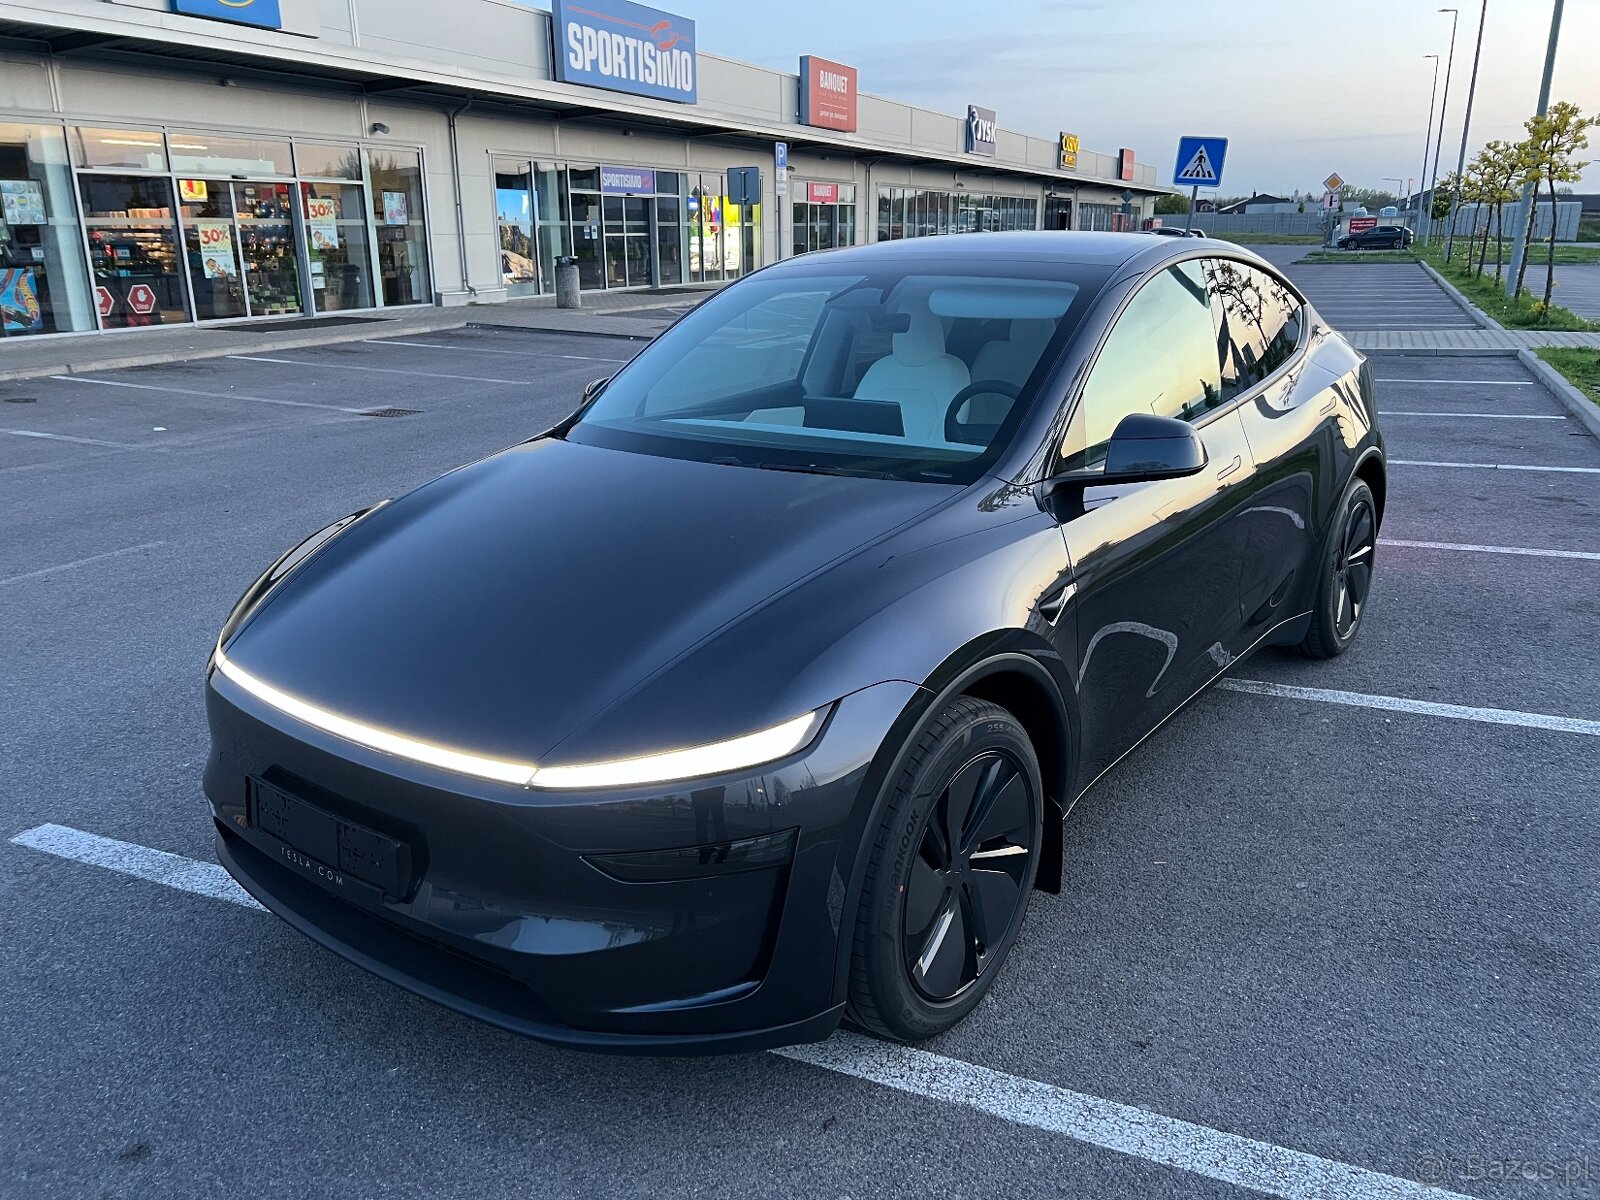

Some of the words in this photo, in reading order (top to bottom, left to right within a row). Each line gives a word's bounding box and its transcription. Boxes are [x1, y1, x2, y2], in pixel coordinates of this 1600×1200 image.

[567, 21, 692, 92] SPORTISIMO
[819, 69, 848, 94] BANQUET
[976, 118, 997, 143] JYSK
[778, 146, 785, 165] P
[602, 172, 642, 189] SPORTISIMO
[813, 185, 832, 197] BANQUET
[310, 204, 333, 218] 30%
[201, 228, 228, 245] 30%
[281, 847, 343, 886] TESLA.COM
